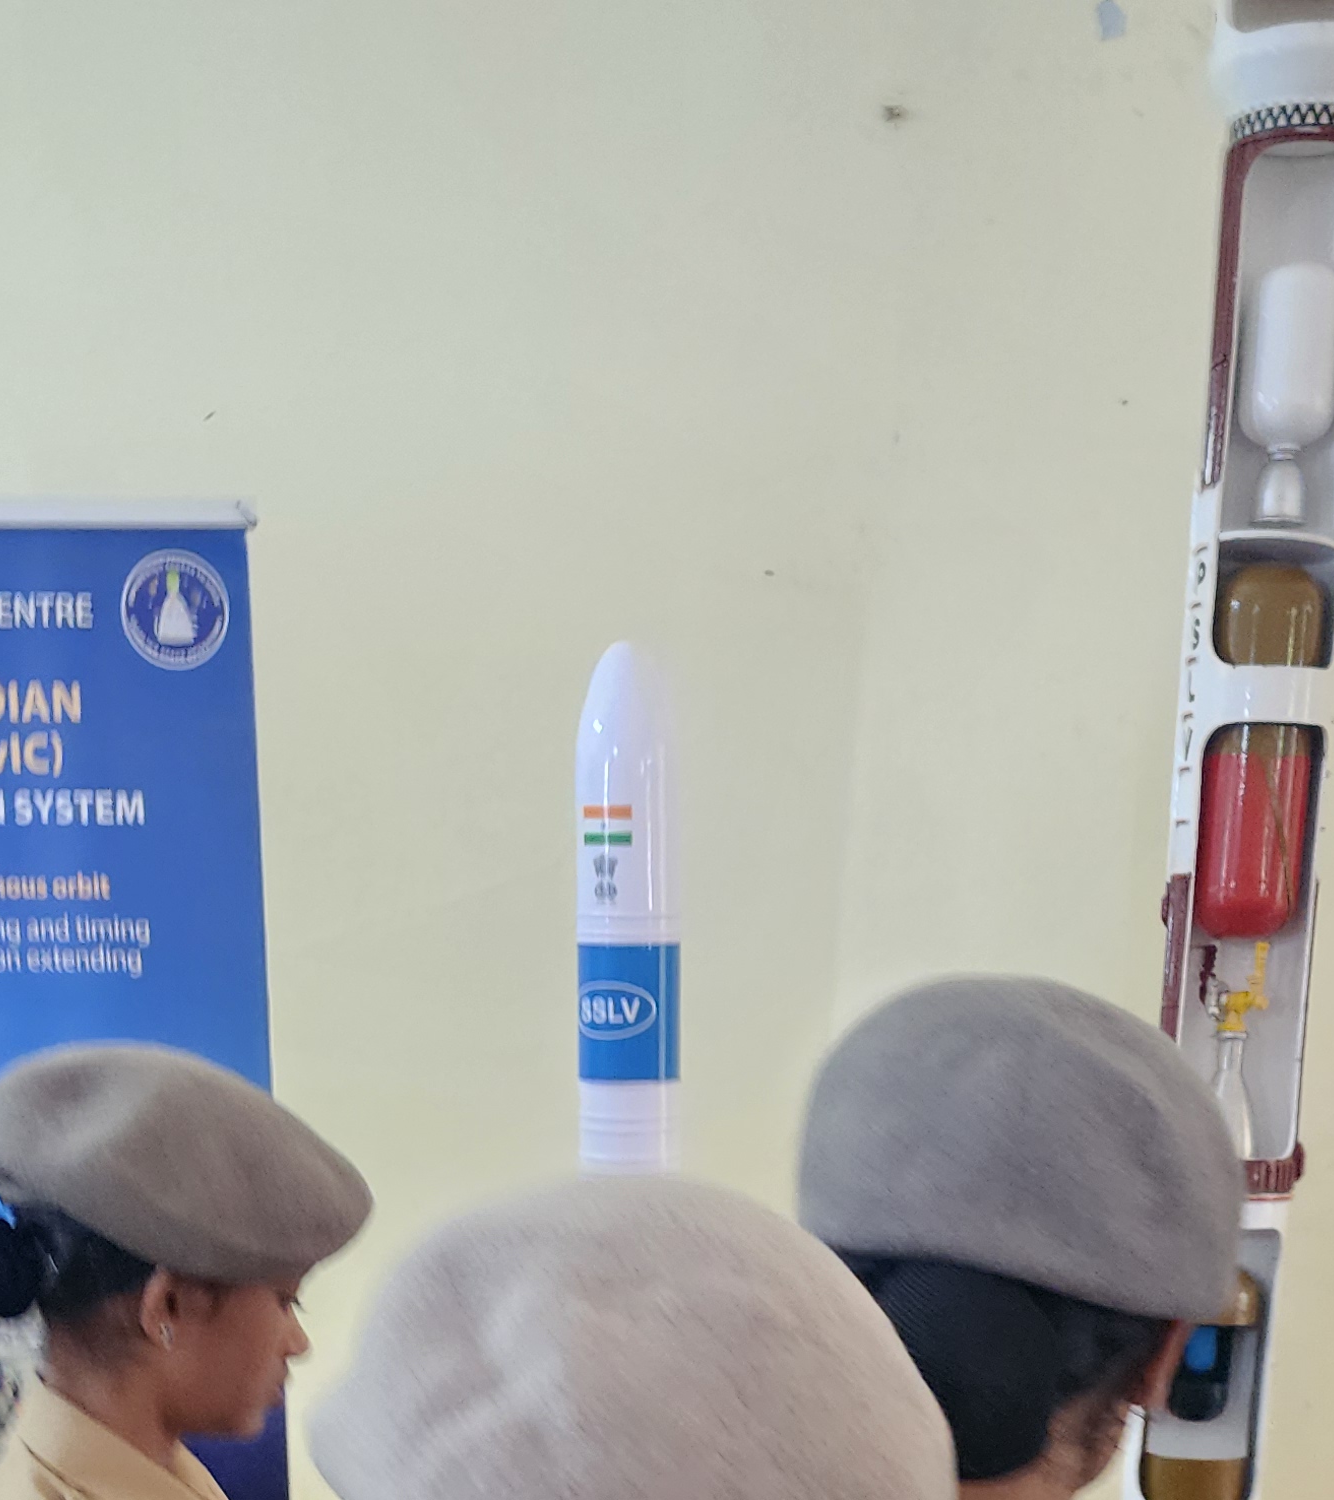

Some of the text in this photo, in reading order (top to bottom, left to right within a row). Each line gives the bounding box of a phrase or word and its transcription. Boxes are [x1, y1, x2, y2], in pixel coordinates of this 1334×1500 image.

[14, 786, 146, 827] SYSTEM
[52, 869, 111, 901] orbit
[26, 911, 71, 944] and
[75, 912, 151, 949] timing
[26, 942, 143, 980] extending
